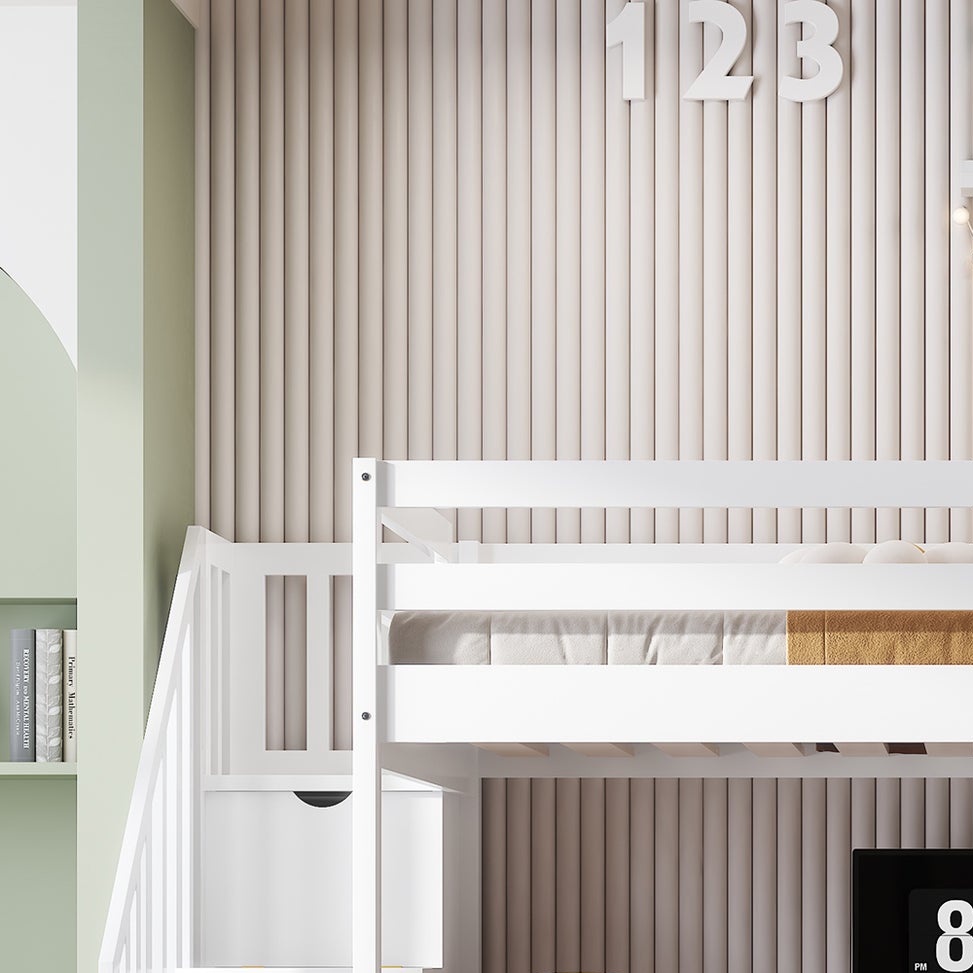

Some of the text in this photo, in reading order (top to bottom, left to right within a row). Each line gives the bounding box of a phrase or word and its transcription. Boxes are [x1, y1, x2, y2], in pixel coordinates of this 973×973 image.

[67, 656, 76, 739] Primary Mathematics
[914, 962, 928, 972] PM
